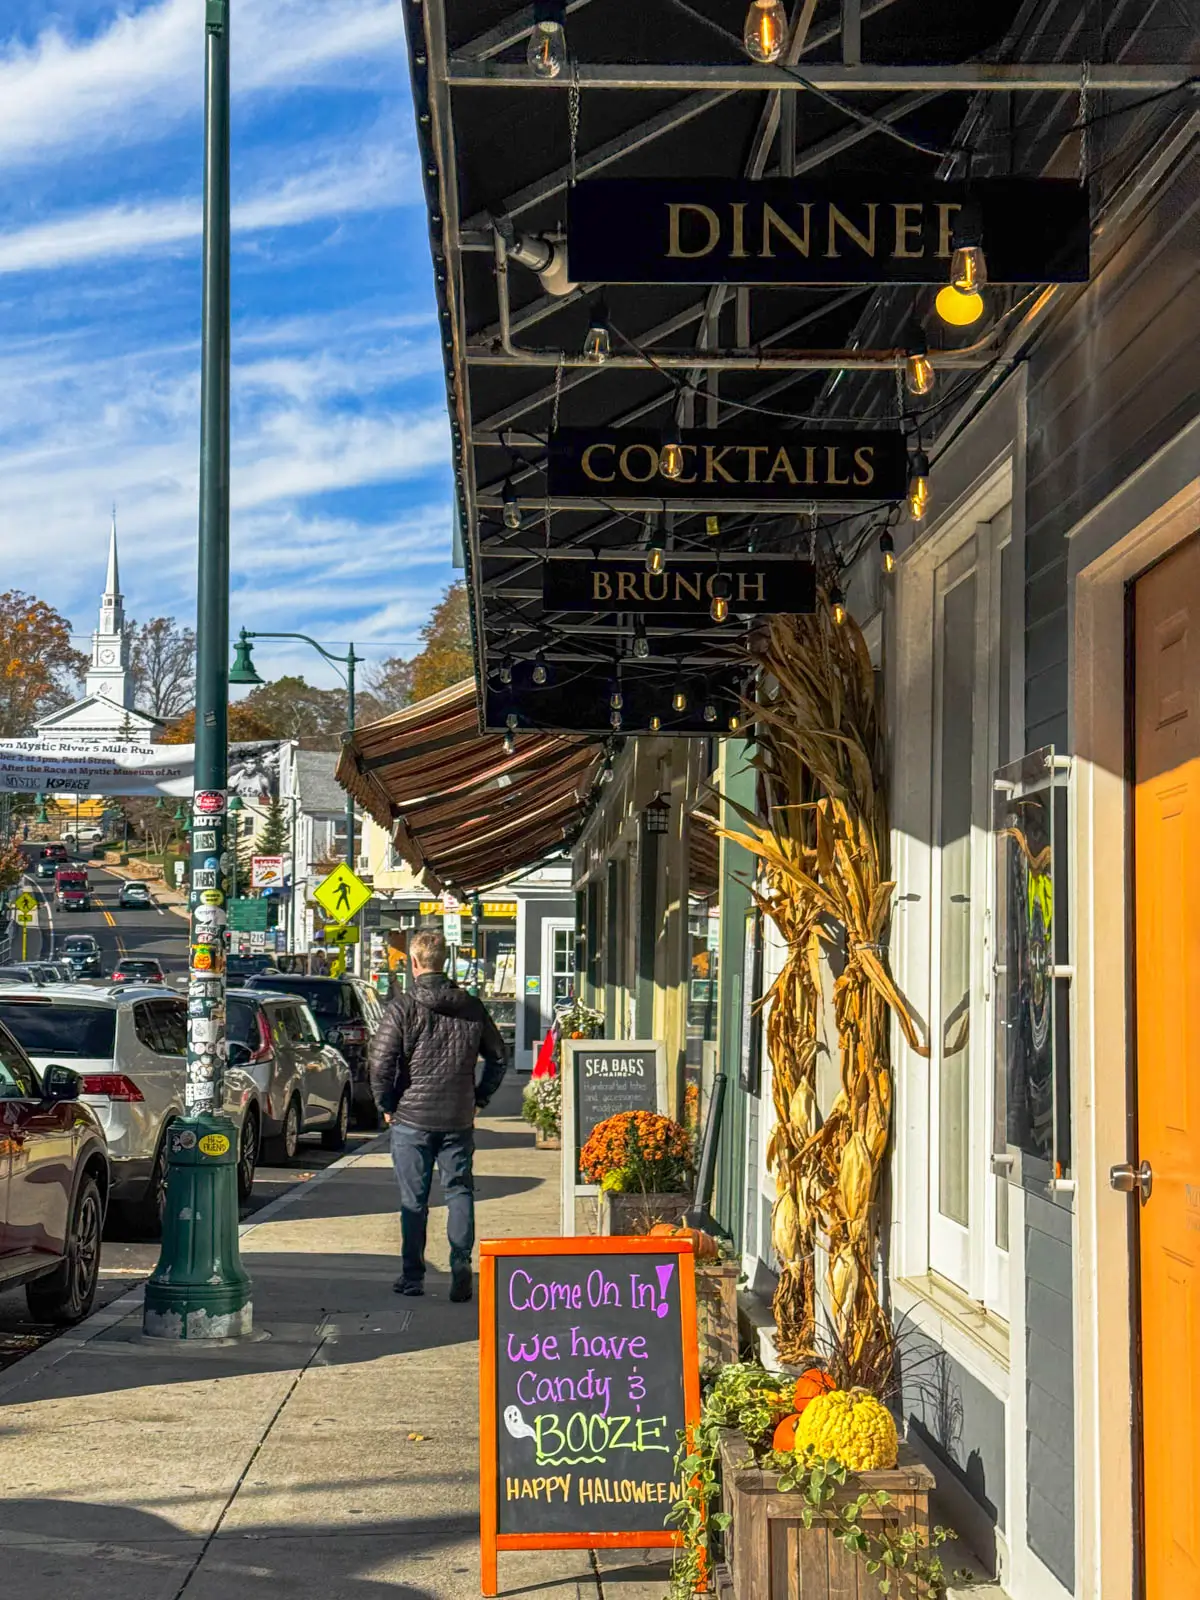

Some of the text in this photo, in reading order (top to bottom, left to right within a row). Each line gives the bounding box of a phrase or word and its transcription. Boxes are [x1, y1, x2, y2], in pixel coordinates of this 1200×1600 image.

[580, 442, 876, 485] COCKTAILS
[590, 569, 767, 603] BRUNCH
[16, 741, 57, 752] Mystic
[59, 743, 90, 752] River
[102, 745, 128, 753] Mile
[130, 746, 154, 755] Run
[1, 763, 24, 772] After
[26, 765, 42, 773] the
[43, 765, 67, 774] Race
[79, 767, 111, 776] Mystic
[113, 768, 154, 776] Museum
[88, 757, 116, 765] Street
[6, 774, 41, 788] MYSTIC
[251, 932, 264, 943] 215
[586, 1058, 644, 1077] SEA BAGS
[203, 1143, 227, 1152] FRIEND
[509, 1263, 675, 1318] Come On In!
[570, 1326, 649, 1360] have
[516, 1369, 612, 1418] Candy
[534, 1411, 670, 1459] BOOZE
[506, 1474, 572, 1503] HAPPY
